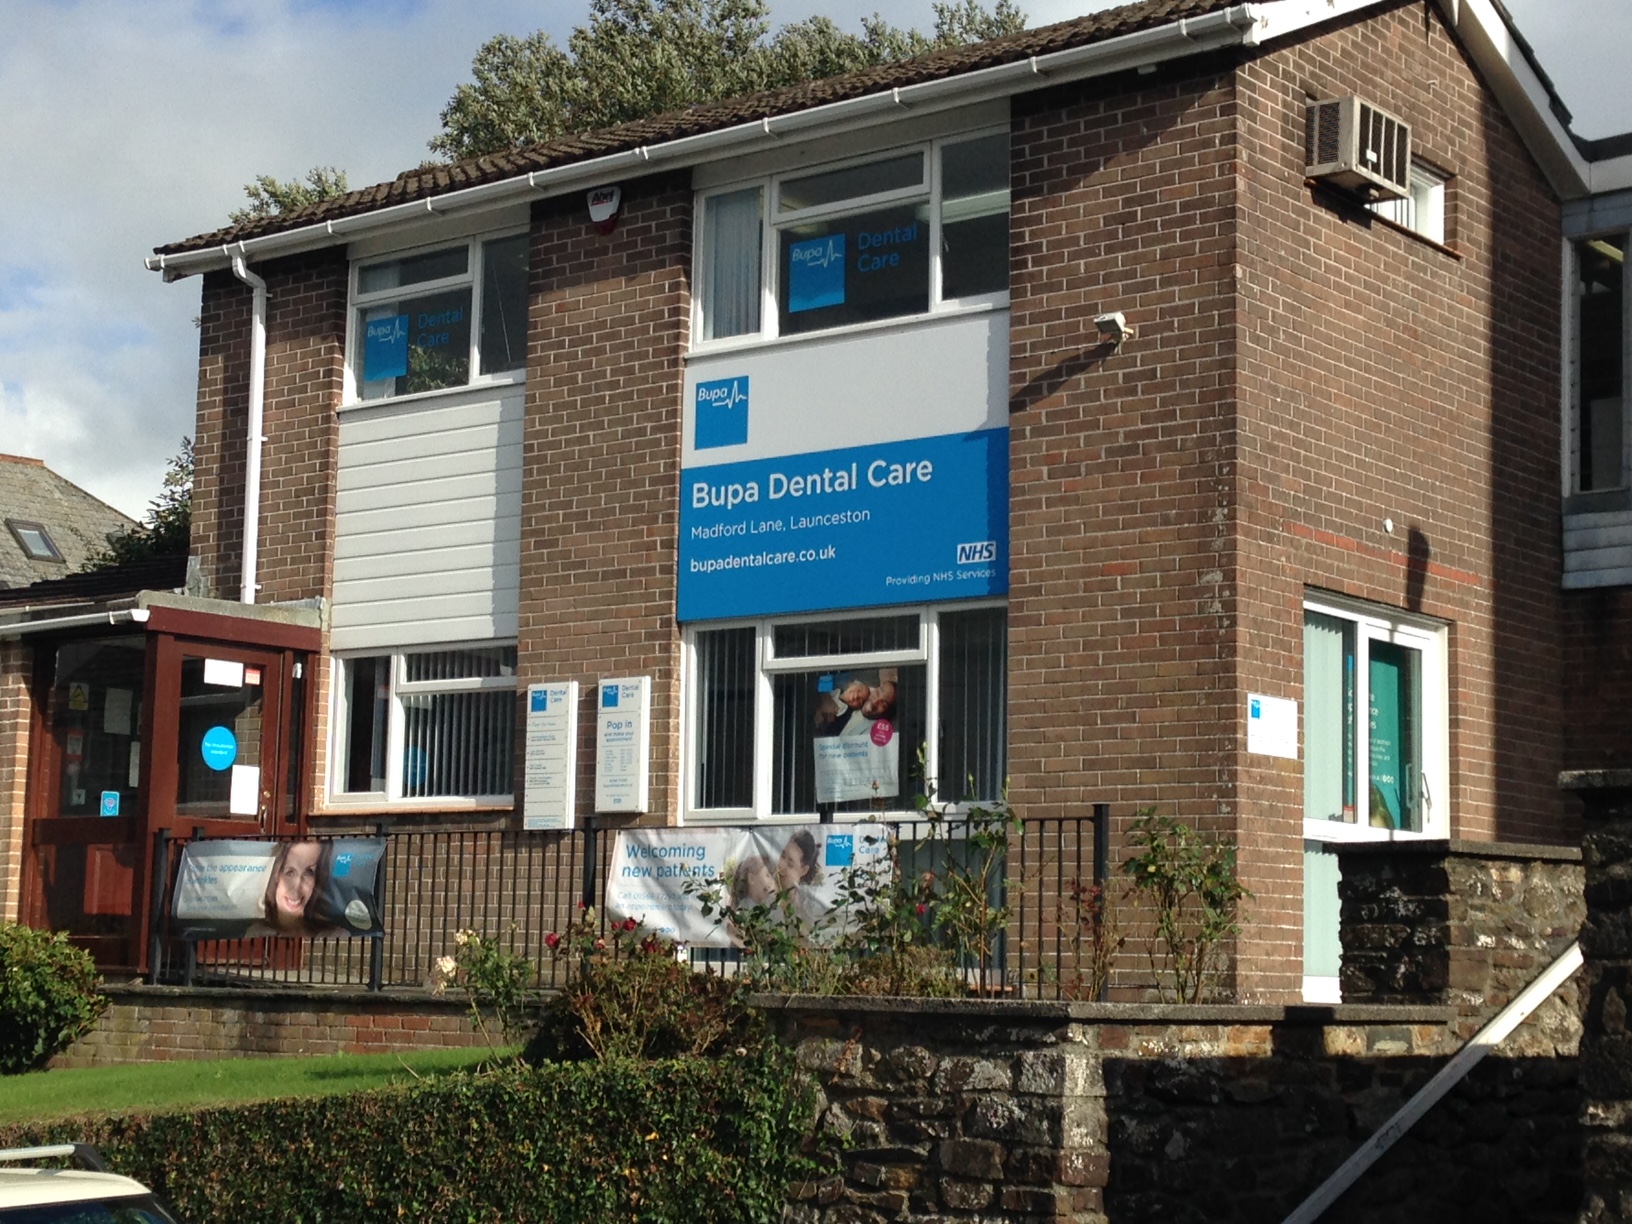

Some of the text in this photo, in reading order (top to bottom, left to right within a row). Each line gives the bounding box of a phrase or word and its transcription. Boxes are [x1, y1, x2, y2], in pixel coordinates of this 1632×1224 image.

[858, 221, 918, 250] Dental
[792, 246, 822, 262] Bupa
[857, 252, 899, 273] Care
[417, 307, 464, 329] Dental
[367, 325, 391, 338] Bupa
[417, 332, 450, 348] Care
[698, 386, 728, 402] Bupa
[692, 459, 933, 509] Bupa Dental Care
[691, 508, 870, 540] Madford Lane, Launceston
[690, 545, 836, 573] bupadentalcare.co.uk
[958, 542, 995, 563] NHS
[886, 567, 996, 586] Providing NHS Services
[607, 720, 632, 730] Pop in
[626, 843, 706, 860] Welcoming
[859, 846, 880, 854] Care
[219, 863, 267, 873] appearance
[622, 866, 652, 878] new
